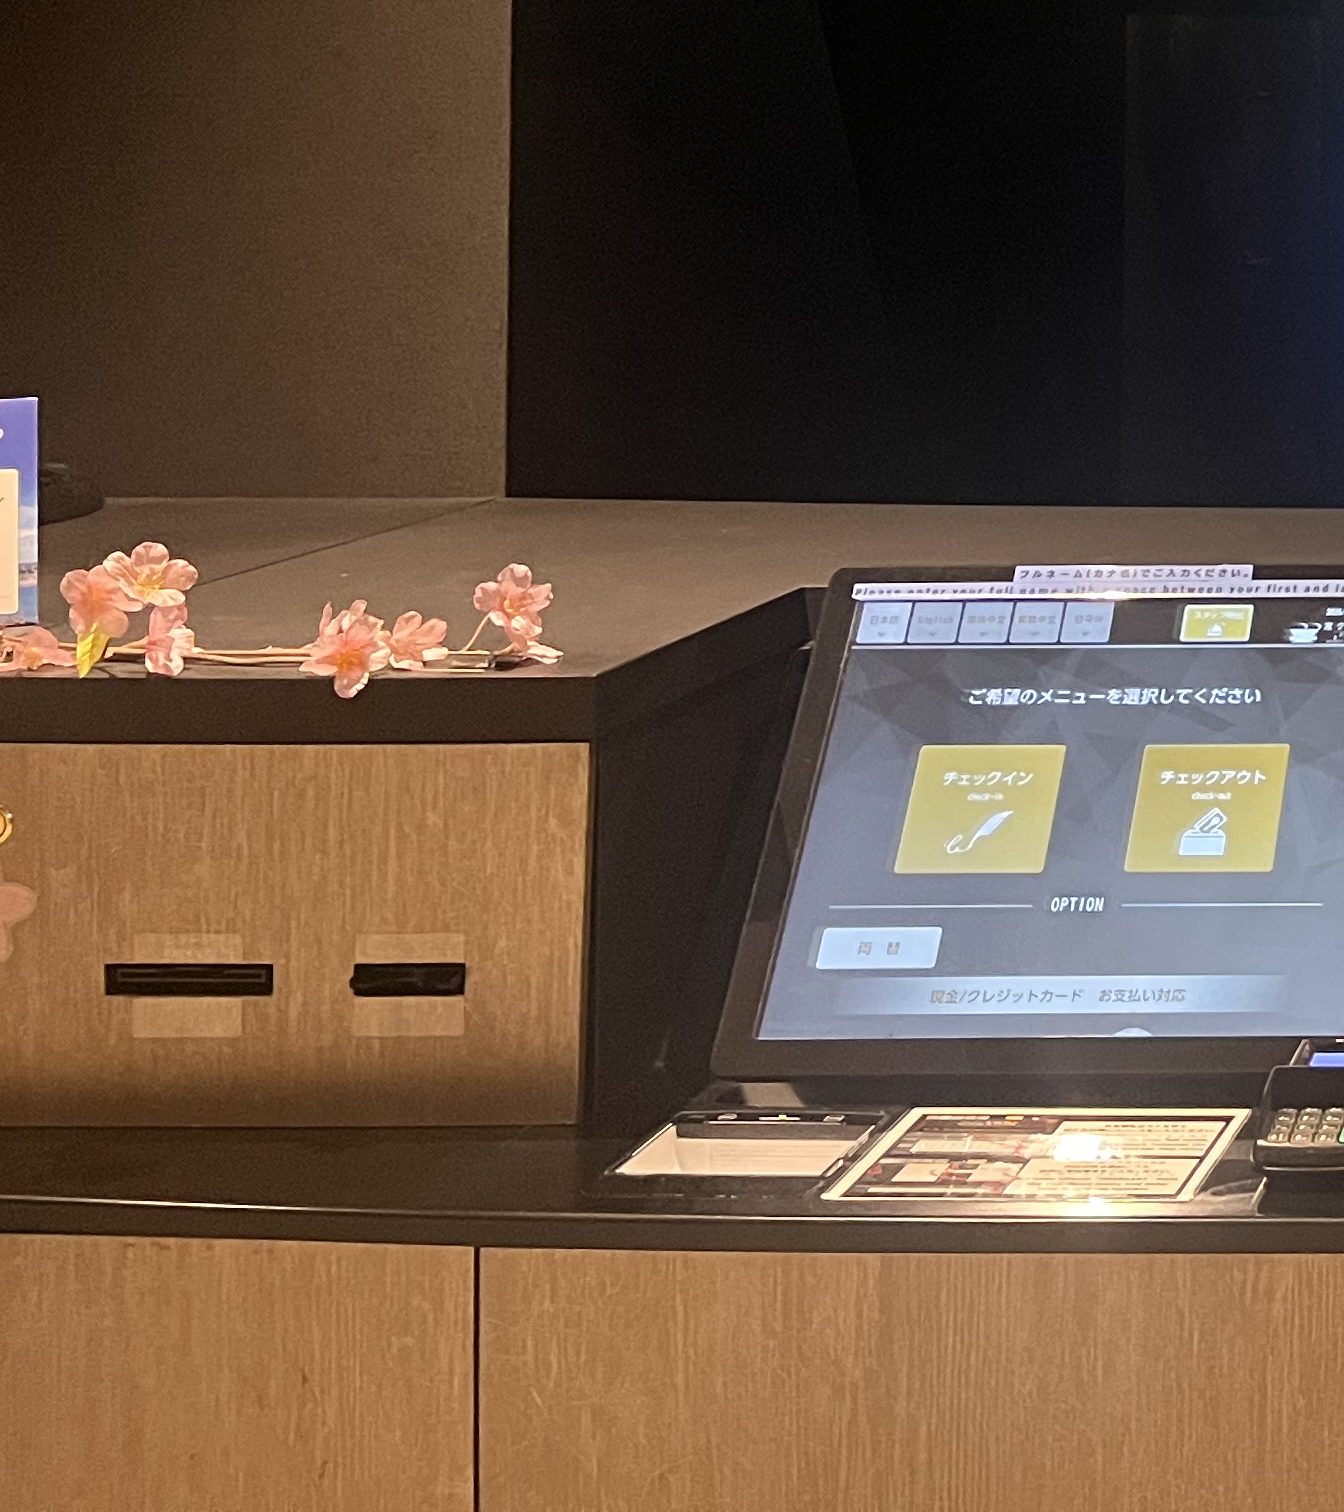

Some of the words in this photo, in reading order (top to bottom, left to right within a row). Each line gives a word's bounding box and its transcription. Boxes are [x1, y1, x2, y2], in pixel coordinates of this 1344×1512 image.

[989, 585, 1013, 595] full
[1162, 584, 1222, 594] between
[1229, 585, 1260, 595] your
[1266, 583, 1298, 594] first
[1304, 584, 1329, 594] and
[917, 615, 954, 626] English
[966, 687, 1262, 706] ご希望のメニューを選択してください
[942, 770, 1034, 786] チェックイン
[1160, 769, 1267, 785] チェックアウト
[1050, 896, 1105, 913] OPTION
[1098, 988, 1187, 1003] お支払い対応
